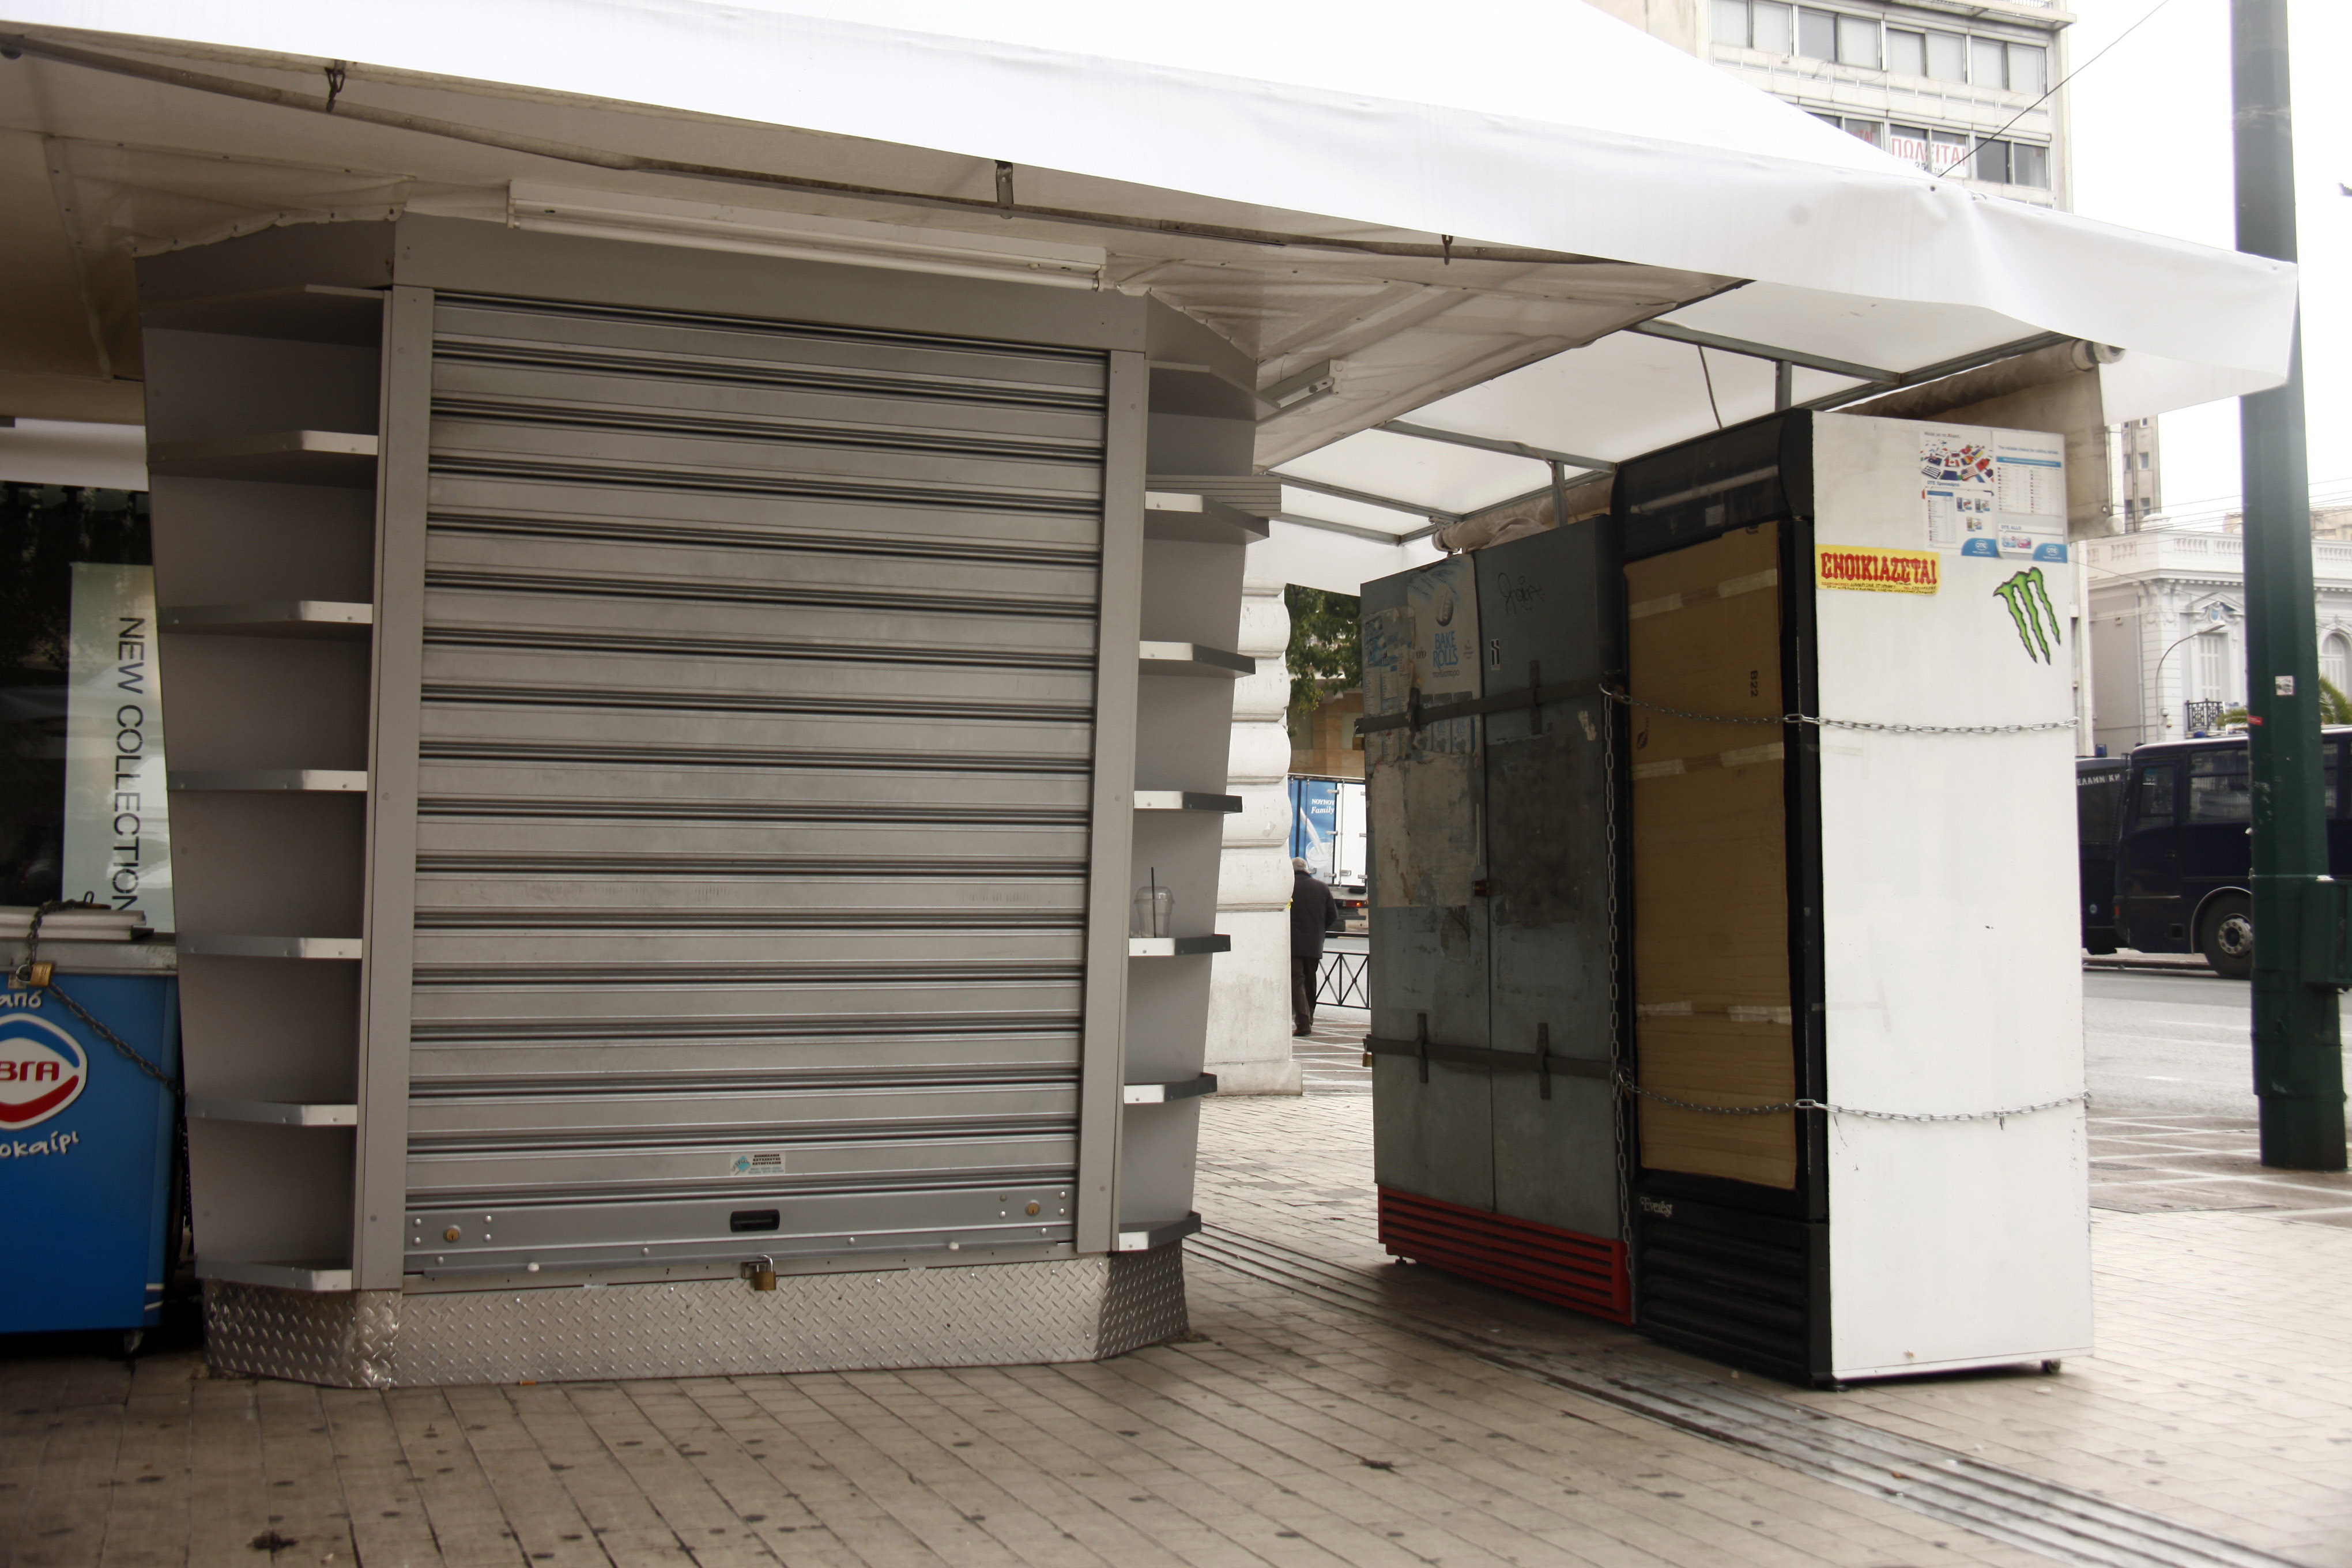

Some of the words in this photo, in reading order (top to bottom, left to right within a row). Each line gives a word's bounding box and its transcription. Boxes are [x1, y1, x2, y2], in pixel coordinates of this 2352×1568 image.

[1820, 552, 1938, 585] ΕΝΟΙΚΙΑΖΕΤΑΙ
[1435, 631, 1456, 650] BAKE
[117, 617, 145, 695] NEW
[1433, 647, 1459, 669] ROLLS
[1750, 669, 1758, 698] B22
[1310, 806, 1335, 815] Family
[1311, 798, 1335, 806] NOYNOY
